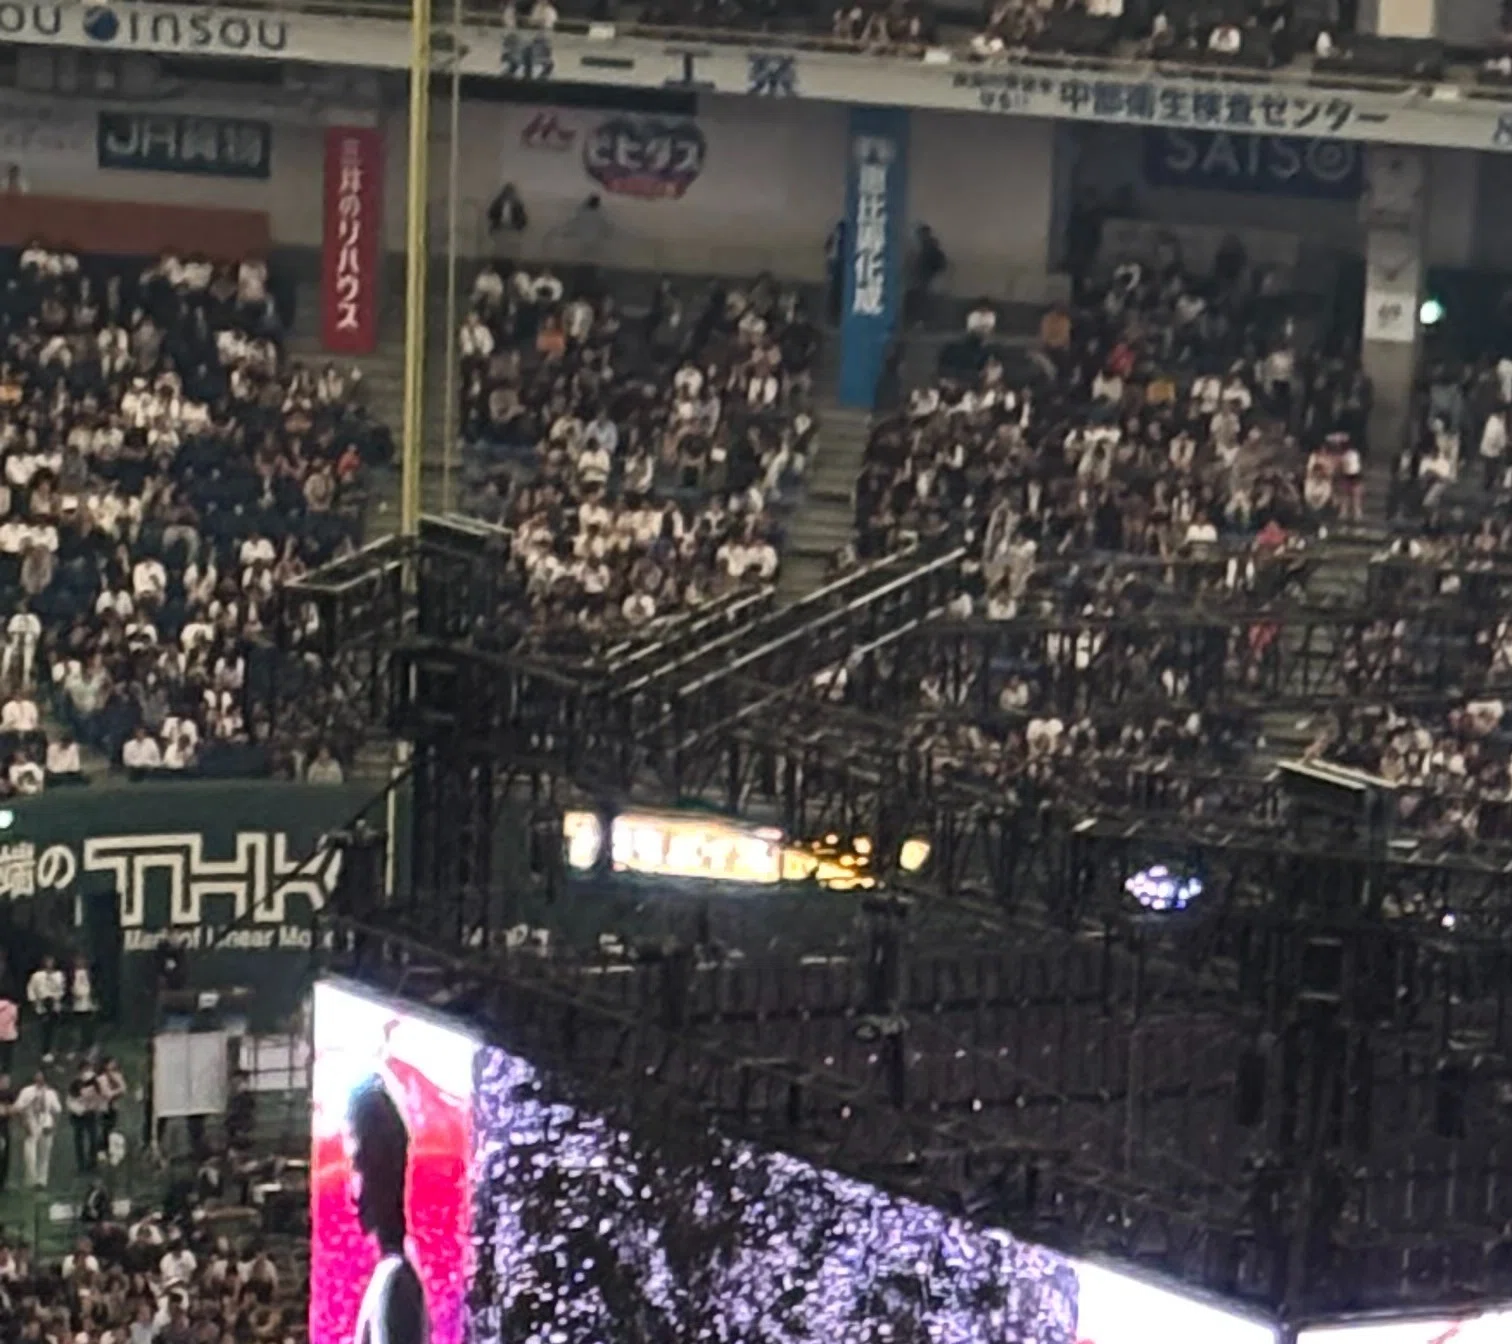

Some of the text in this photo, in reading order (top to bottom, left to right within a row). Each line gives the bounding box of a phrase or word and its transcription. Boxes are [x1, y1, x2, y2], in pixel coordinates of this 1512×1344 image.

[336, 138, 362, 331] 三井のリハウス
[84, 832, 343, 926] THK
